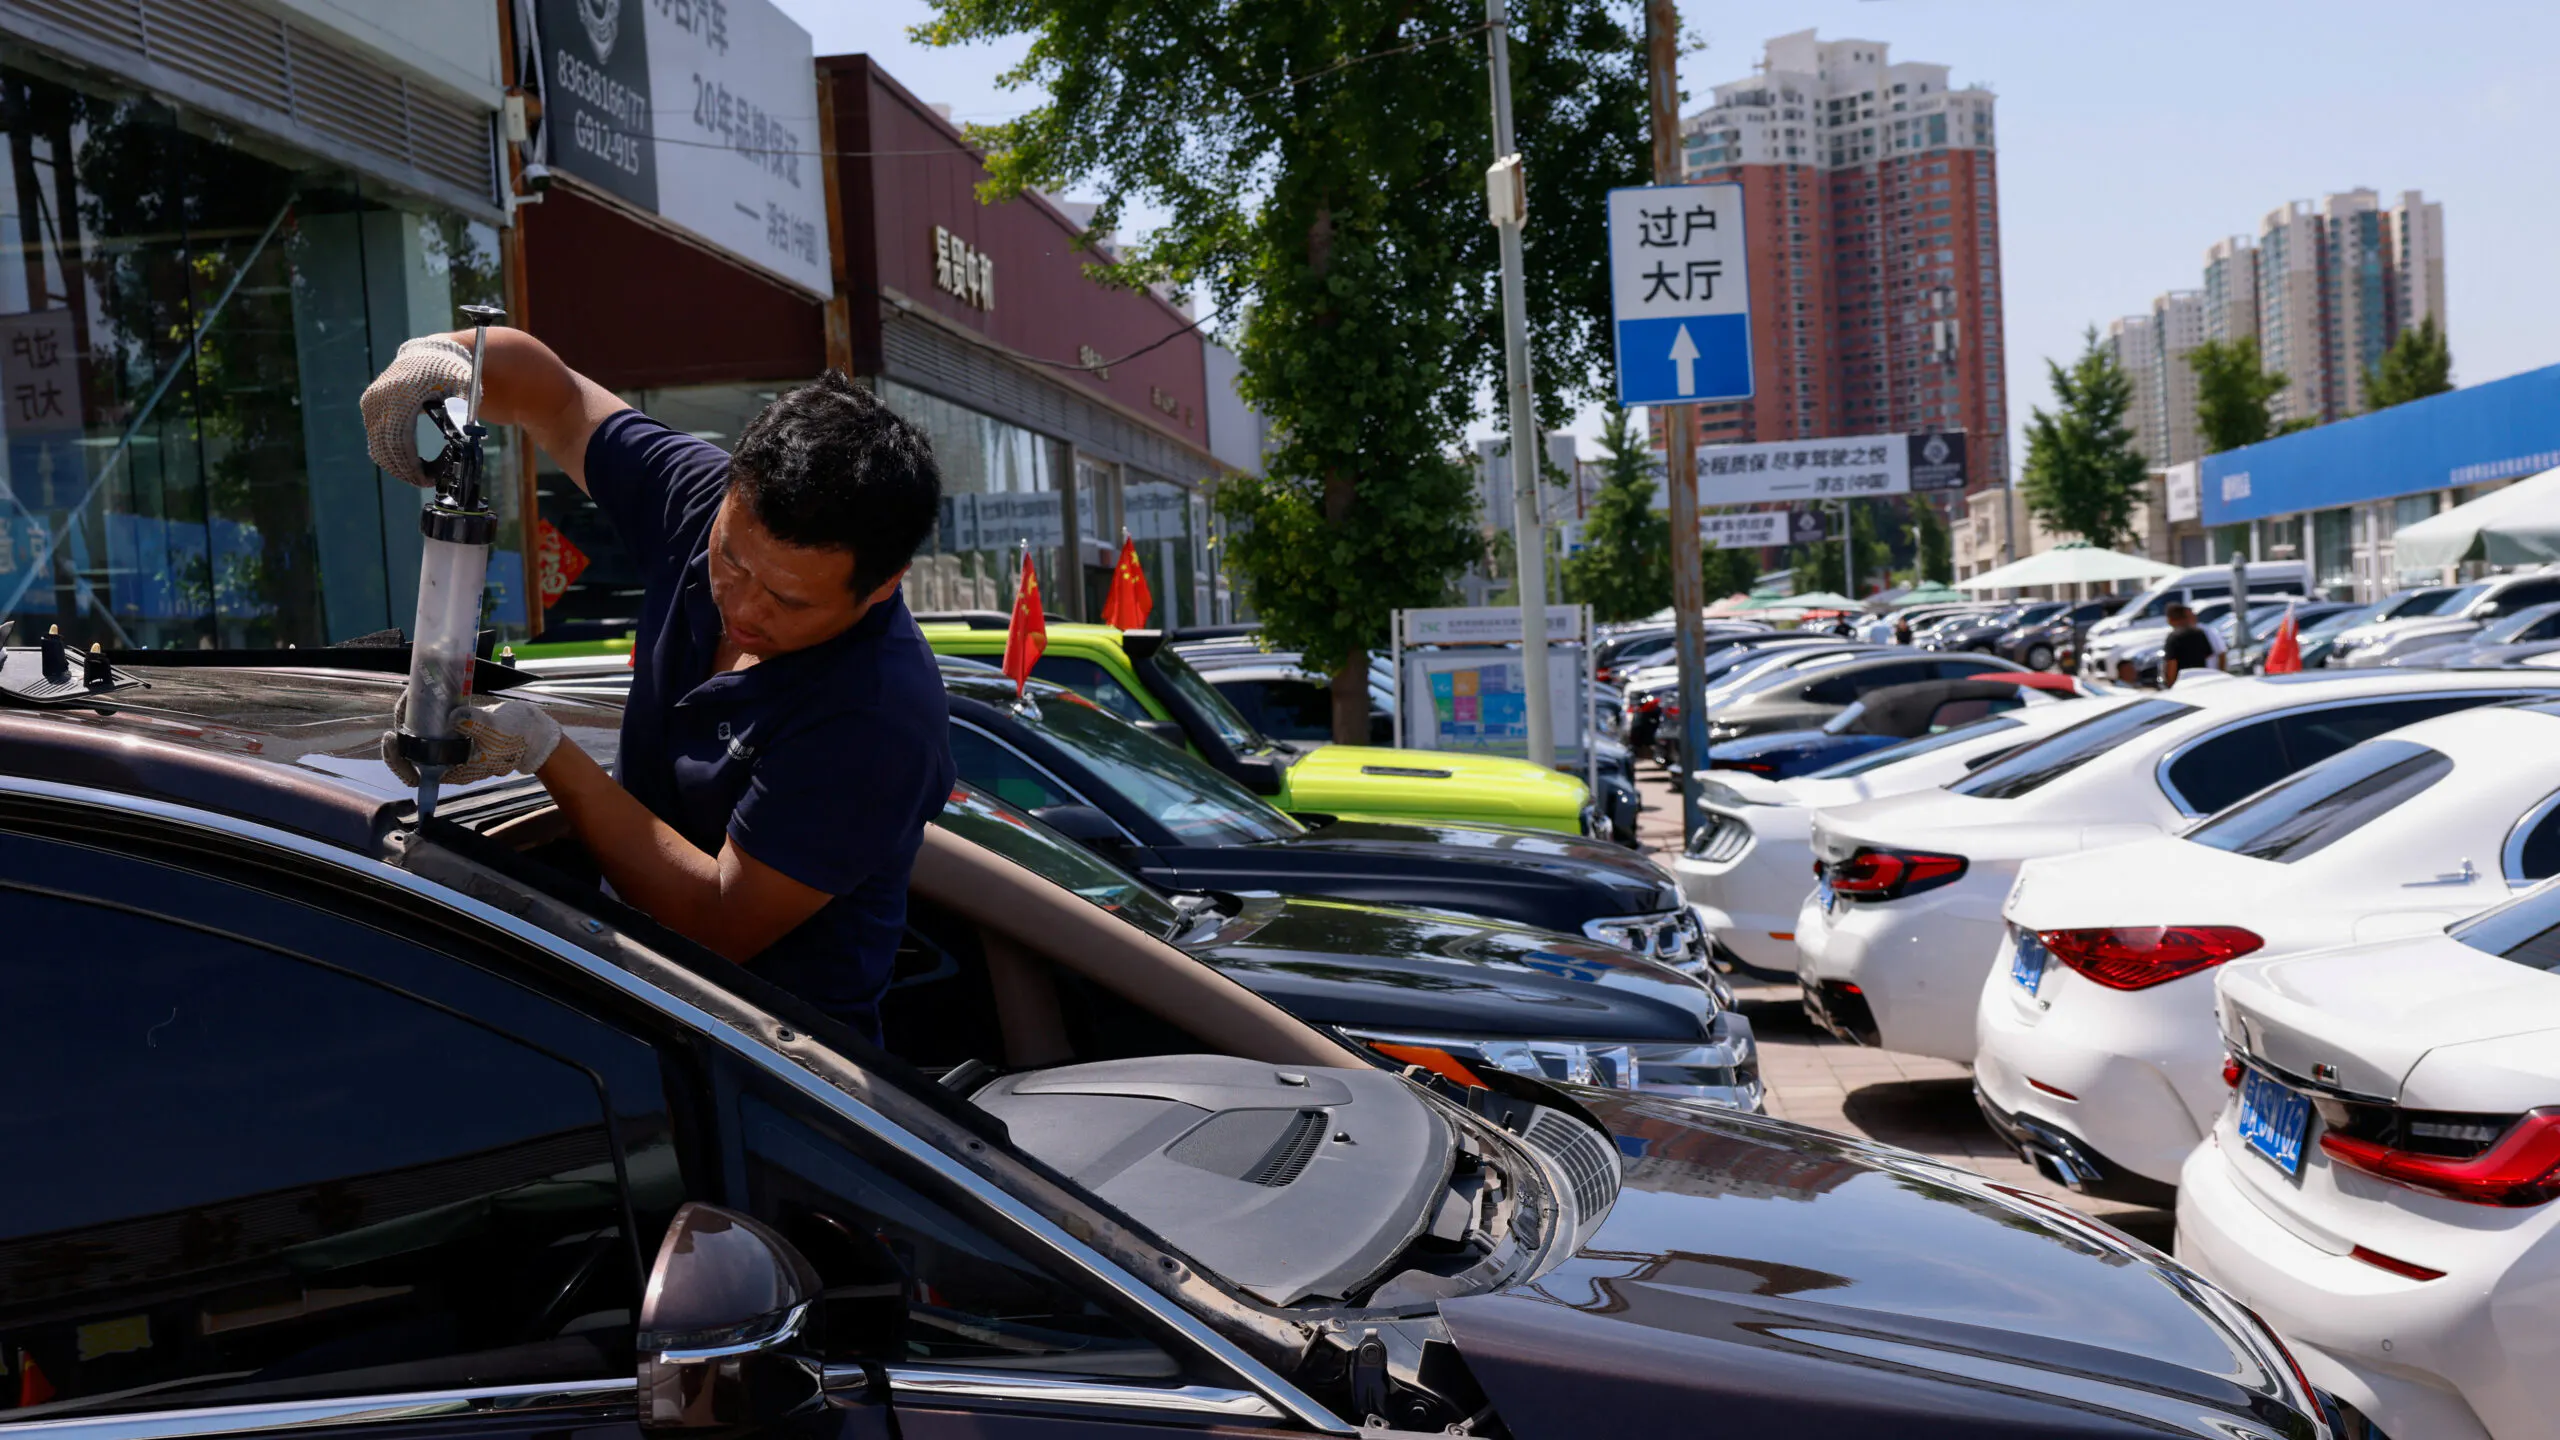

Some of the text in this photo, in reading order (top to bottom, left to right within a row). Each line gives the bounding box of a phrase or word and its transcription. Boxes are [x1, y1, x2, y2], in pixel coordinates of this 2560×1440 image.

[574, 108, 640, 177] G912-915
[1638, 204, 1717, 248] 过户
[1642, 260, 1722, 303] 大厅
